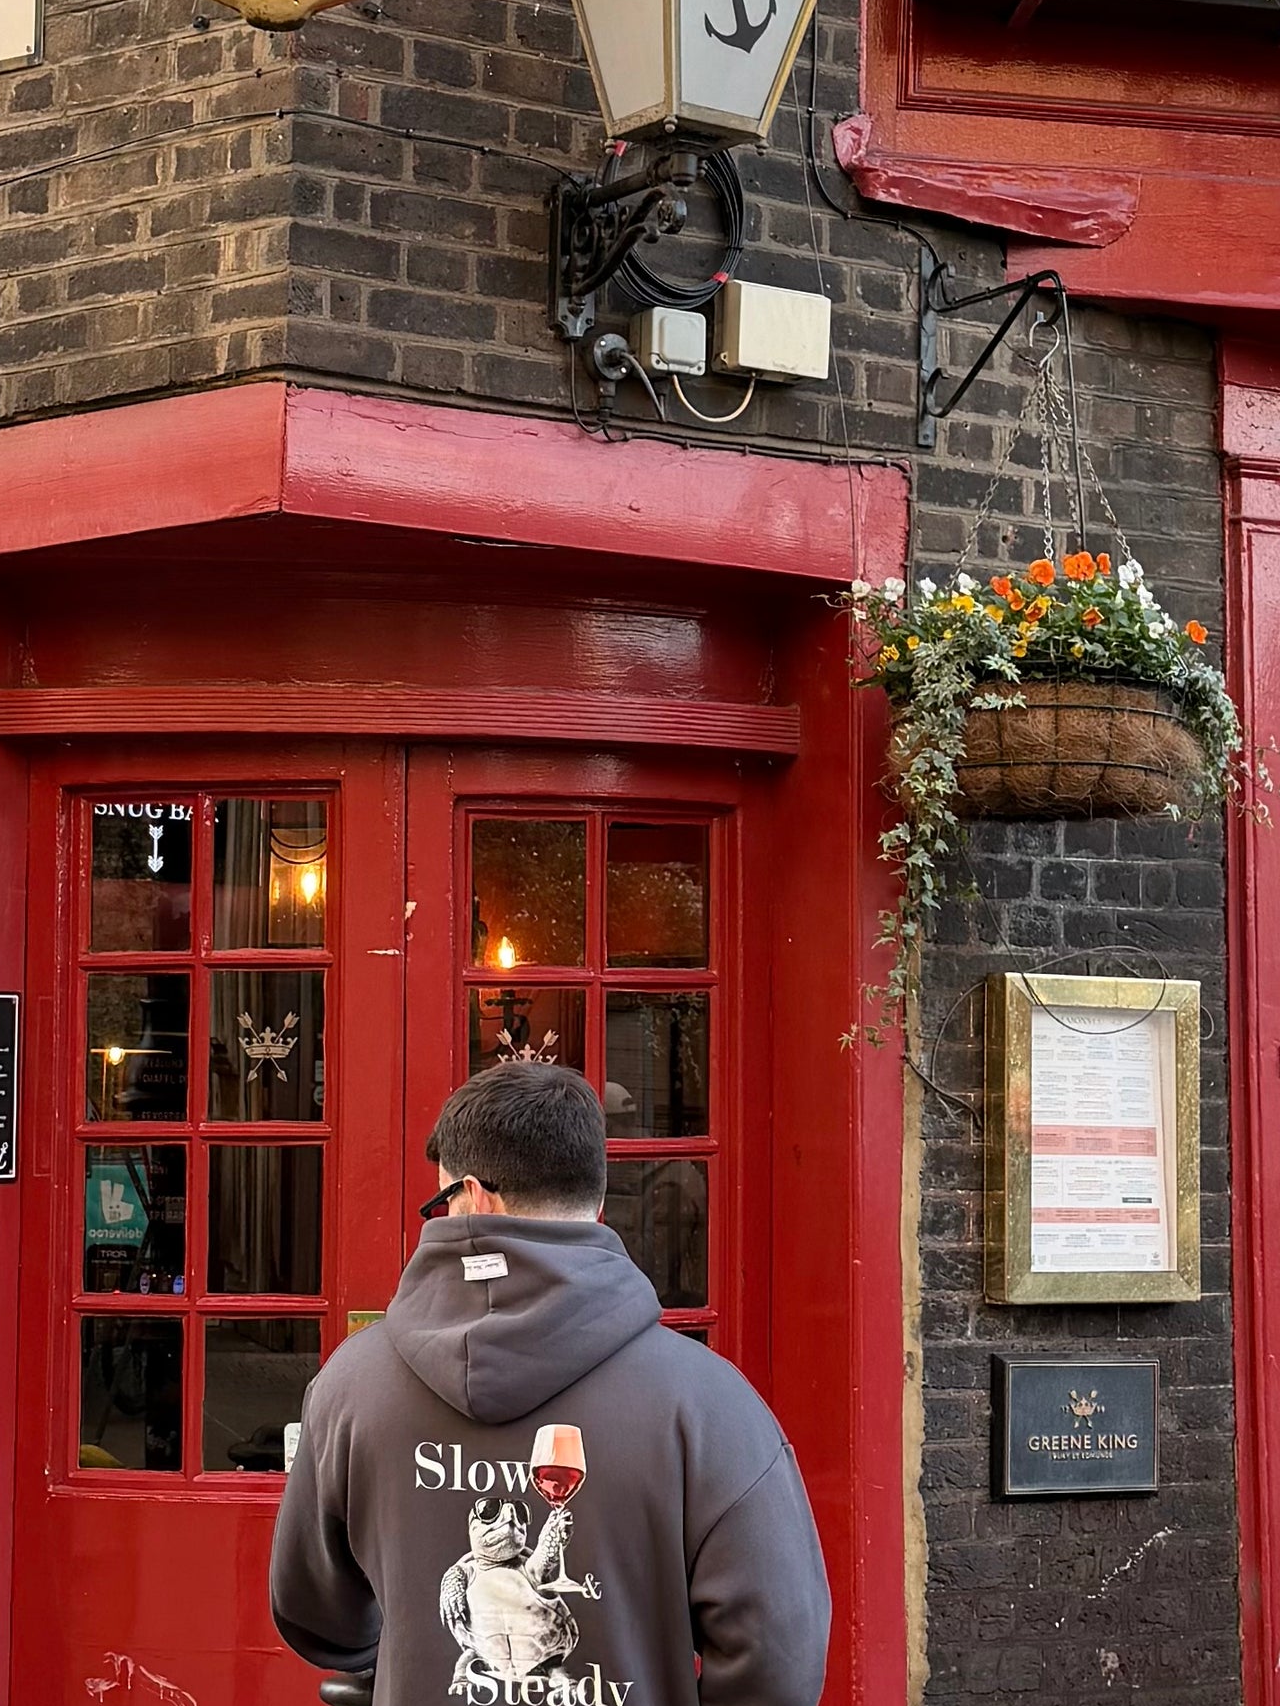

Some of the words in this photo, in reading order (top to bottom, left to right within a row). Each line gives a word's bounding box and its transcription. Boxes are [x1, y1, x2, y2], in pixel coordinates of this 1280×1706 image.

[1028, 1434, 1092, 1451] GREENE
[1097, 1434, 1138, 1450] KING
[414, 1441, 531, 1493] Slow
